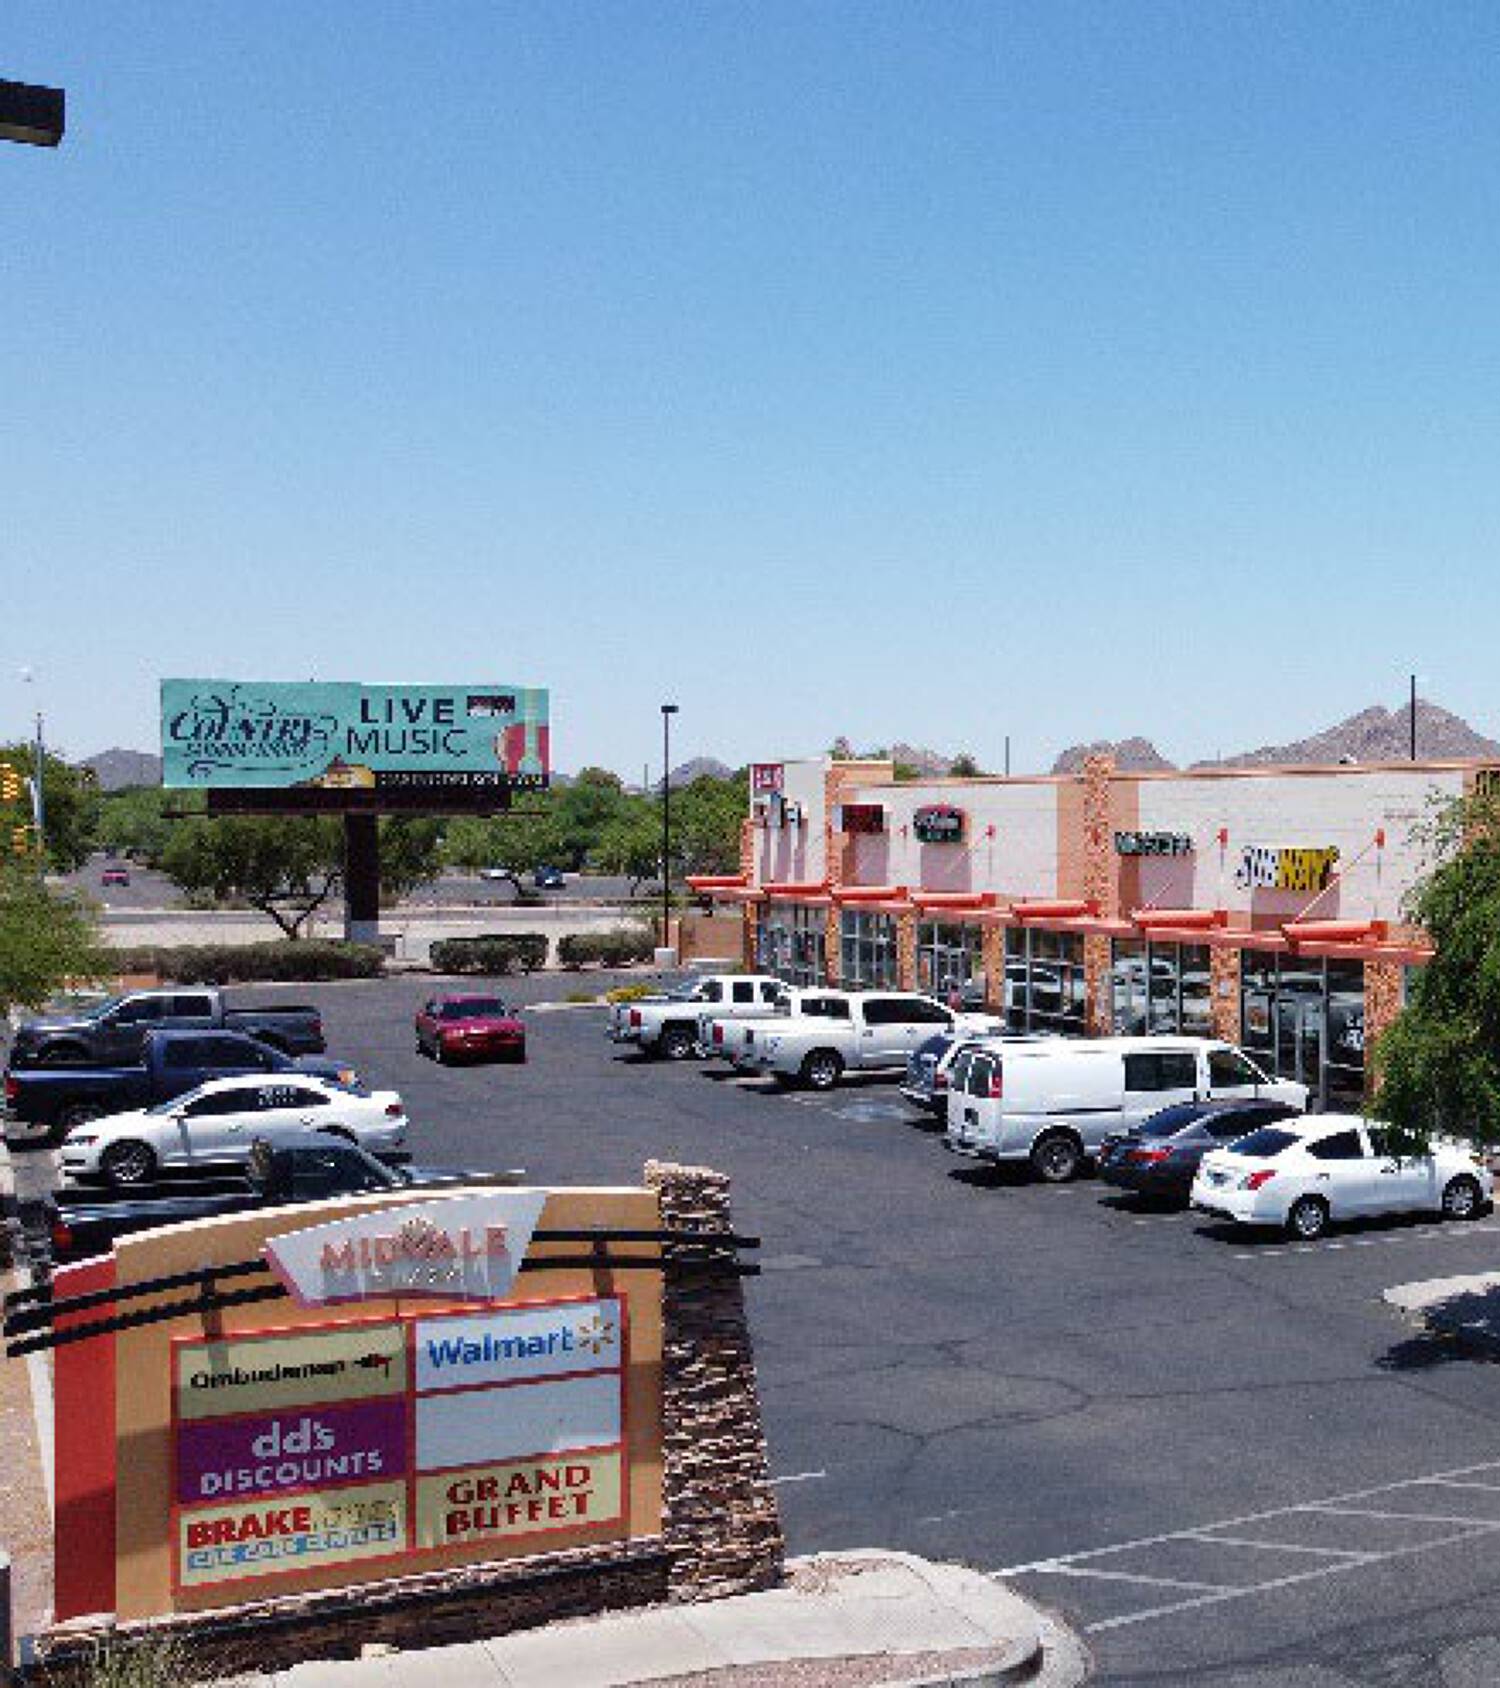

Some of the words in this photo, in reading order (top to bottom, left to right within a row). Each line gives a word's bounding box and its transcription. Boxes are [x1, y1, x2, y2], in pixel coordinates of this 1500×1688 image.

[360, 698, 454, 724] LIVE
[347, 728, 467, 755] MUSIC
[428, 1325, 574, 1369] Walmart
[250, 1418, 336, 1459] dd's
[200, 1450, 383, 1496] DISCOUNTS
[446, 1466, 592, 1505] GRAND
[187, 1507, 311, 1549] BRAKE
[446, 1489, 594, 1537] BUFFET
